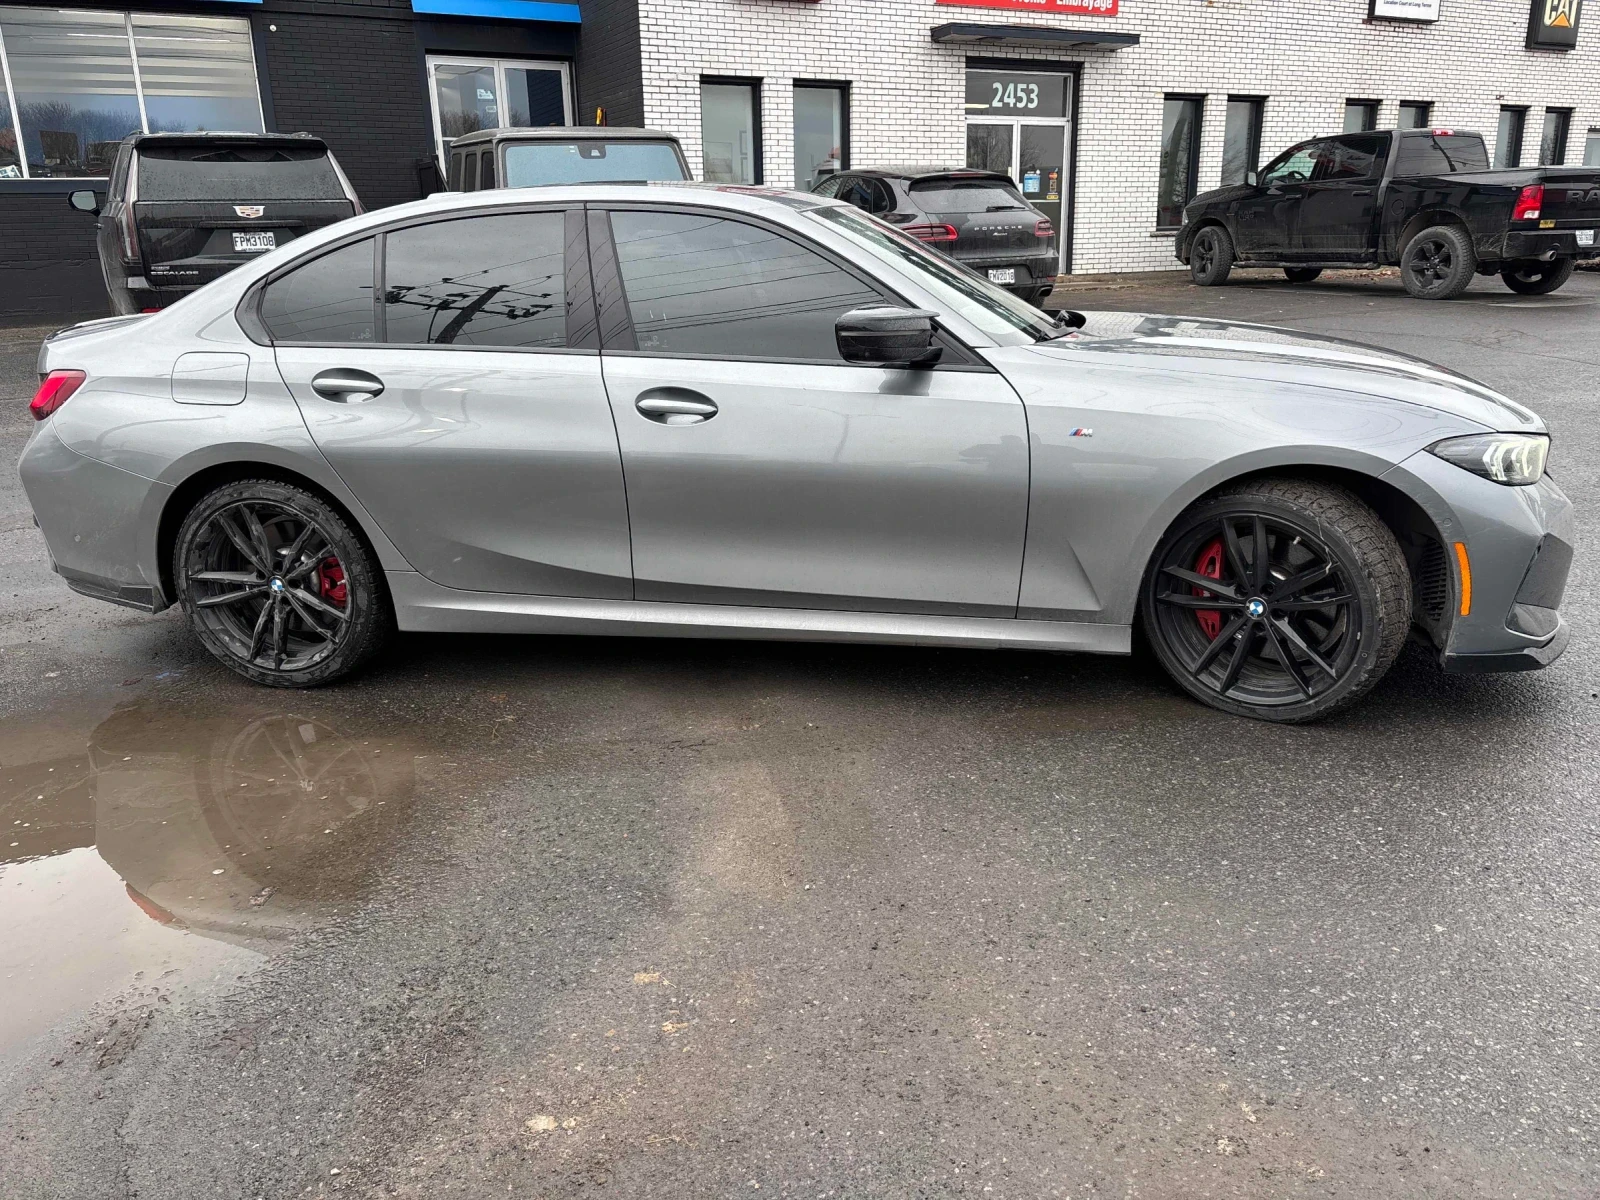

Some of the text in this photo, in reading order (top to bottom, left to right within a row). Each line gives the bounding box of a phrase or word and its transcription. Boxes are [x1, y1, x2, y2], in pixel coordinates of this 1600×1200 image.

[1544, 0, 1579, 28] CAT
[991, 82, 1039, 109] 2453
[234, 236, 274, 247] FPM3108
